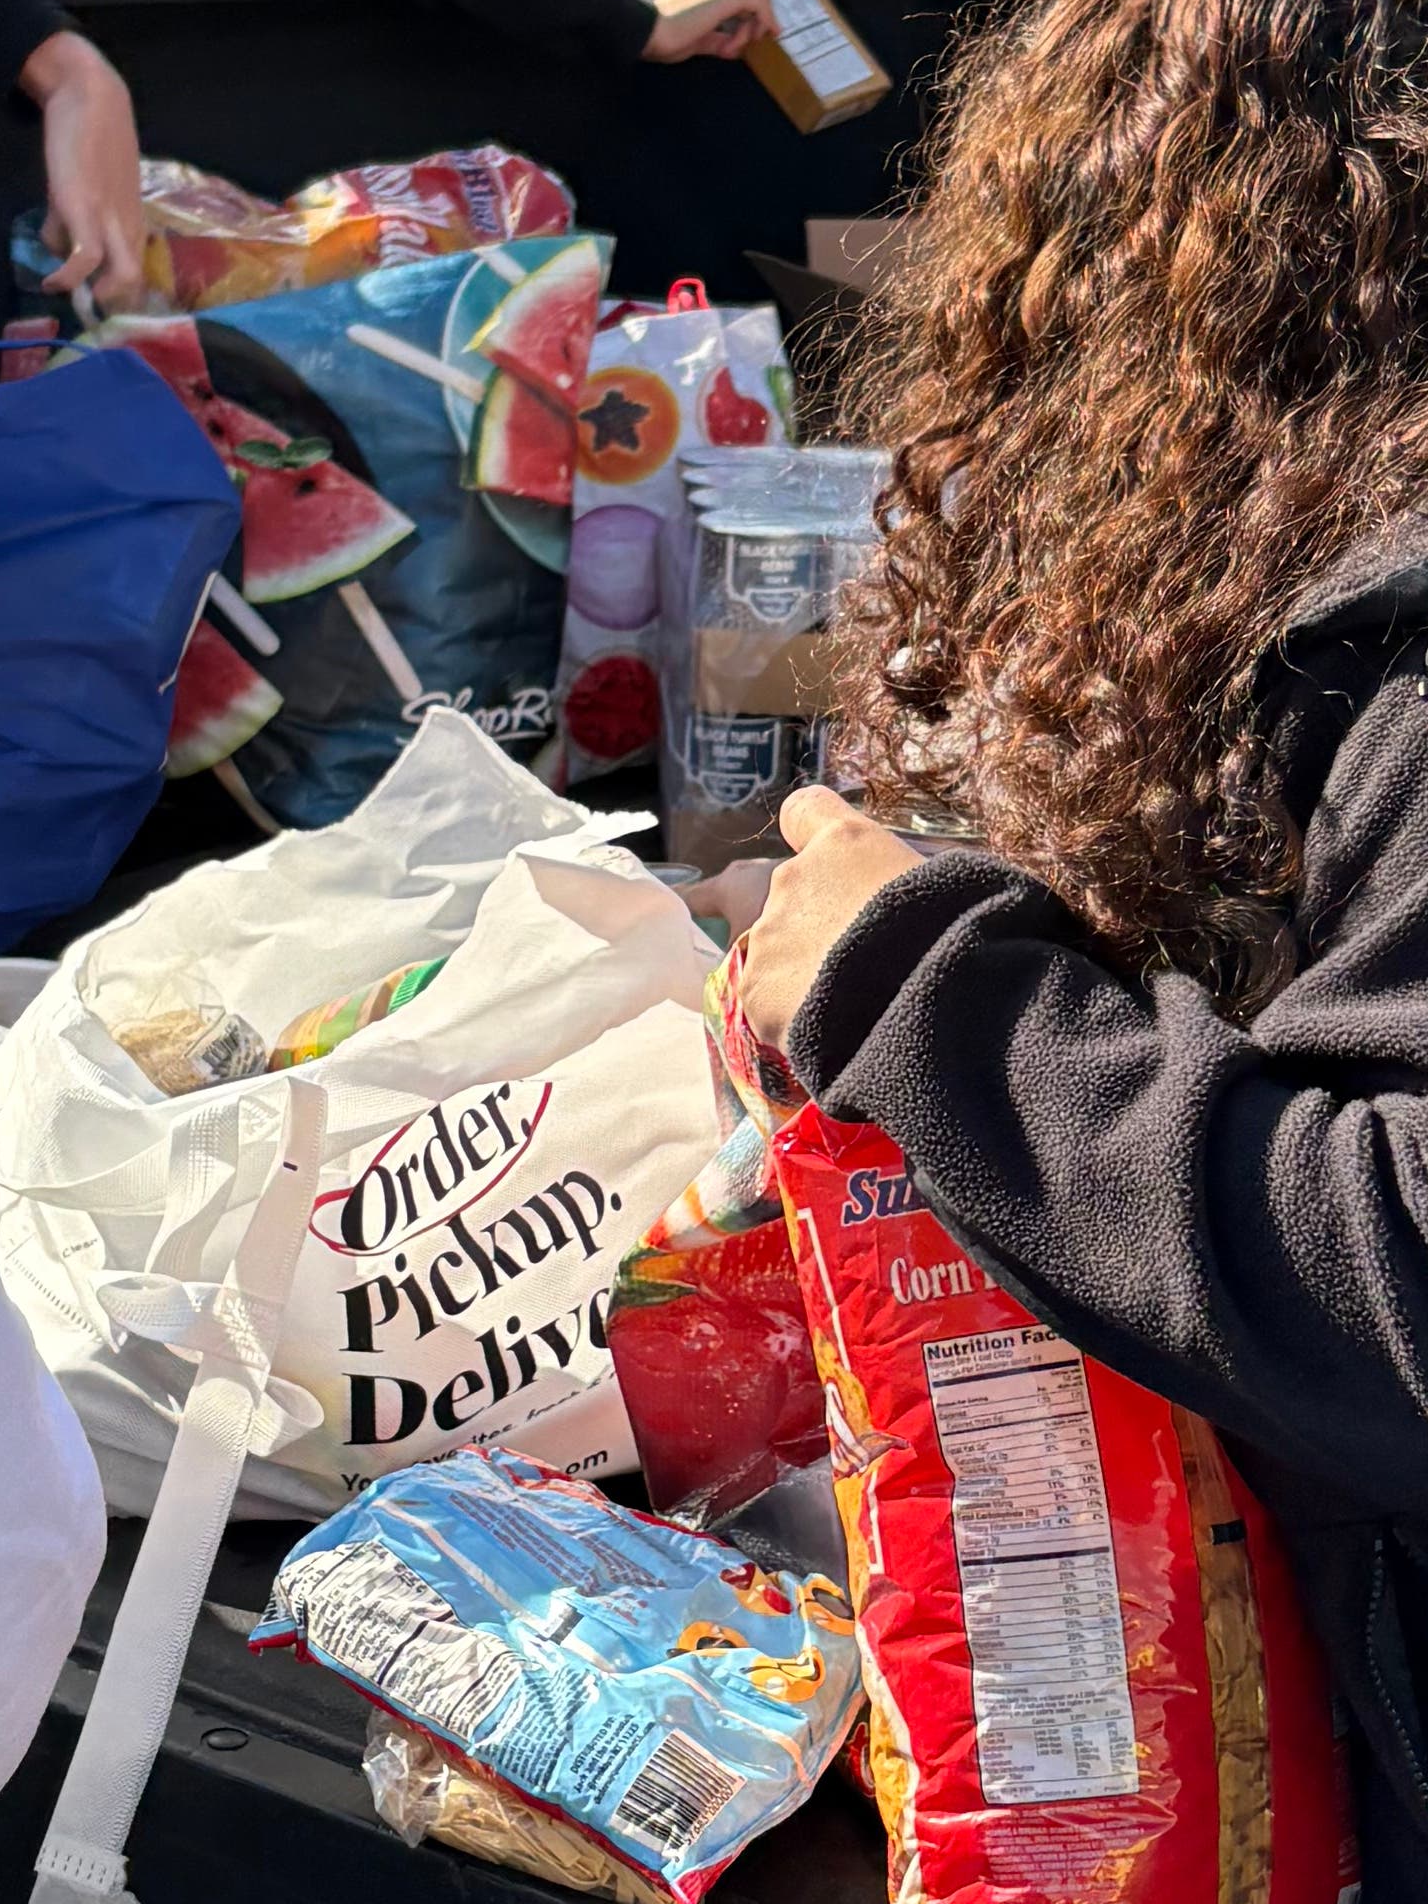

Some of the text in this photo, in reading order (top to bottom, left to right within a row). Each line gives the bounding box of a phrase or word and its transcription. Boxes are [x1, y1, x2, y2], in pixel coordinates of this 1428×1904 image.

[340, 1081, 533, 1251] Order.
[337, 1170, 623, 1354] Pickup.
[890, 1257, 974, 1305] Corn
[927, 1325, 1064, 1362] Nutrition Fac
